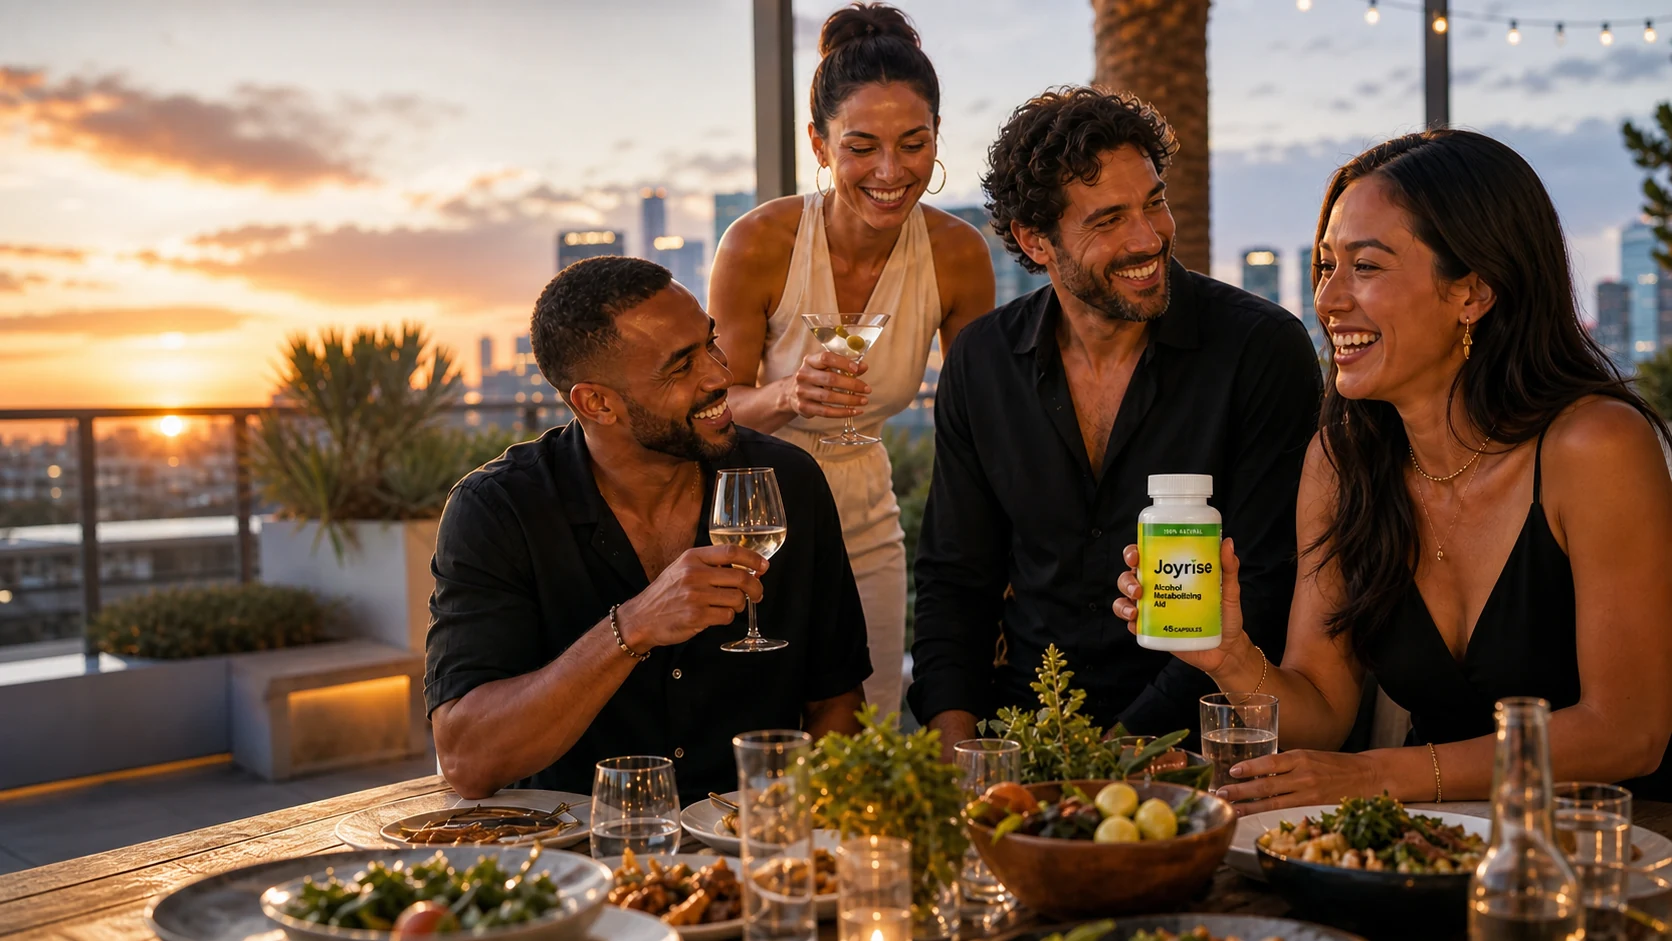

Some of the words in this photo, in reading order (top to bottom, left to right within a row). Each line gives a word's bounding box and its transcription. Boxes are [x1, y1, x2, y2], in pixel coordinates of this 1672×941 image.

[1154, 559, 1213, 579] Joyrise
[1154, 592, 1202, 600] Metabolizing
[1163, 625, 1174, 633] 45
